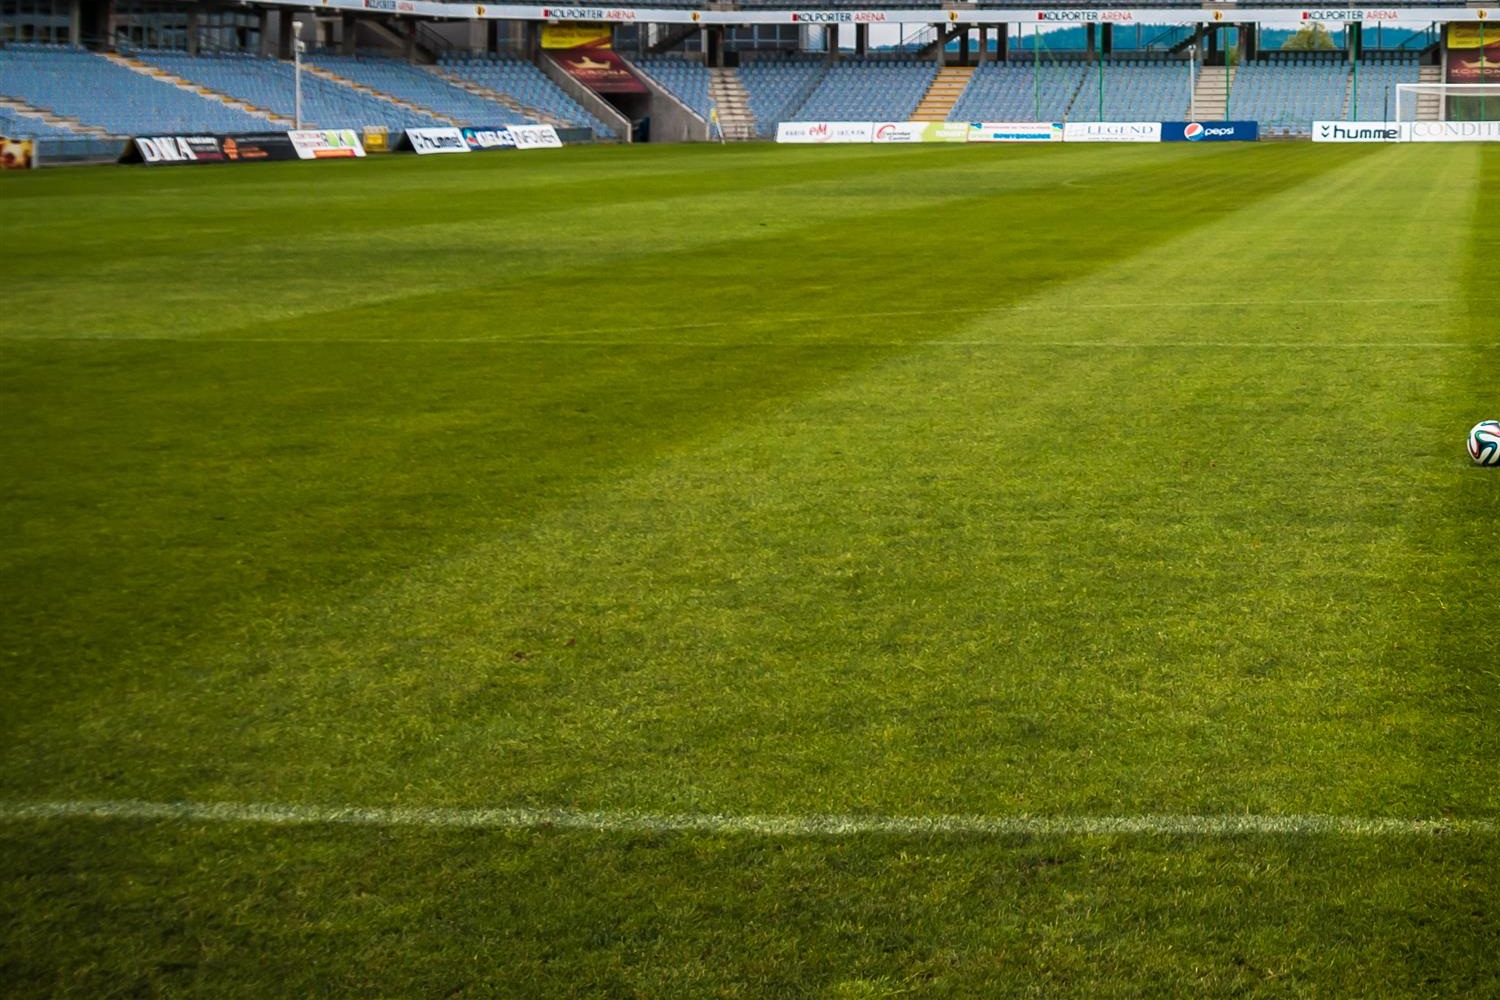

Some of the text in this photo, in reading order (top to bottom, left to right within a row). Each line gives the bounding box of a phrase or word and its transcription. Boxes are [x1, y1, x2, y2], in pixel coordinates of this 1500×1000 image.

[549, 9, 636, 19] KOLPORTER ARENA
[797, 12, 886, 21] KOLPORTER ARENA
[1043, 11, 1132, 20] KOLPORTER ARENA
[1309, 11, 1398, 20] KOLPORTER ARENA
[1088, 126, 1153, 134] LEGEND
[1205, 126, 1234, 136] pepsi
